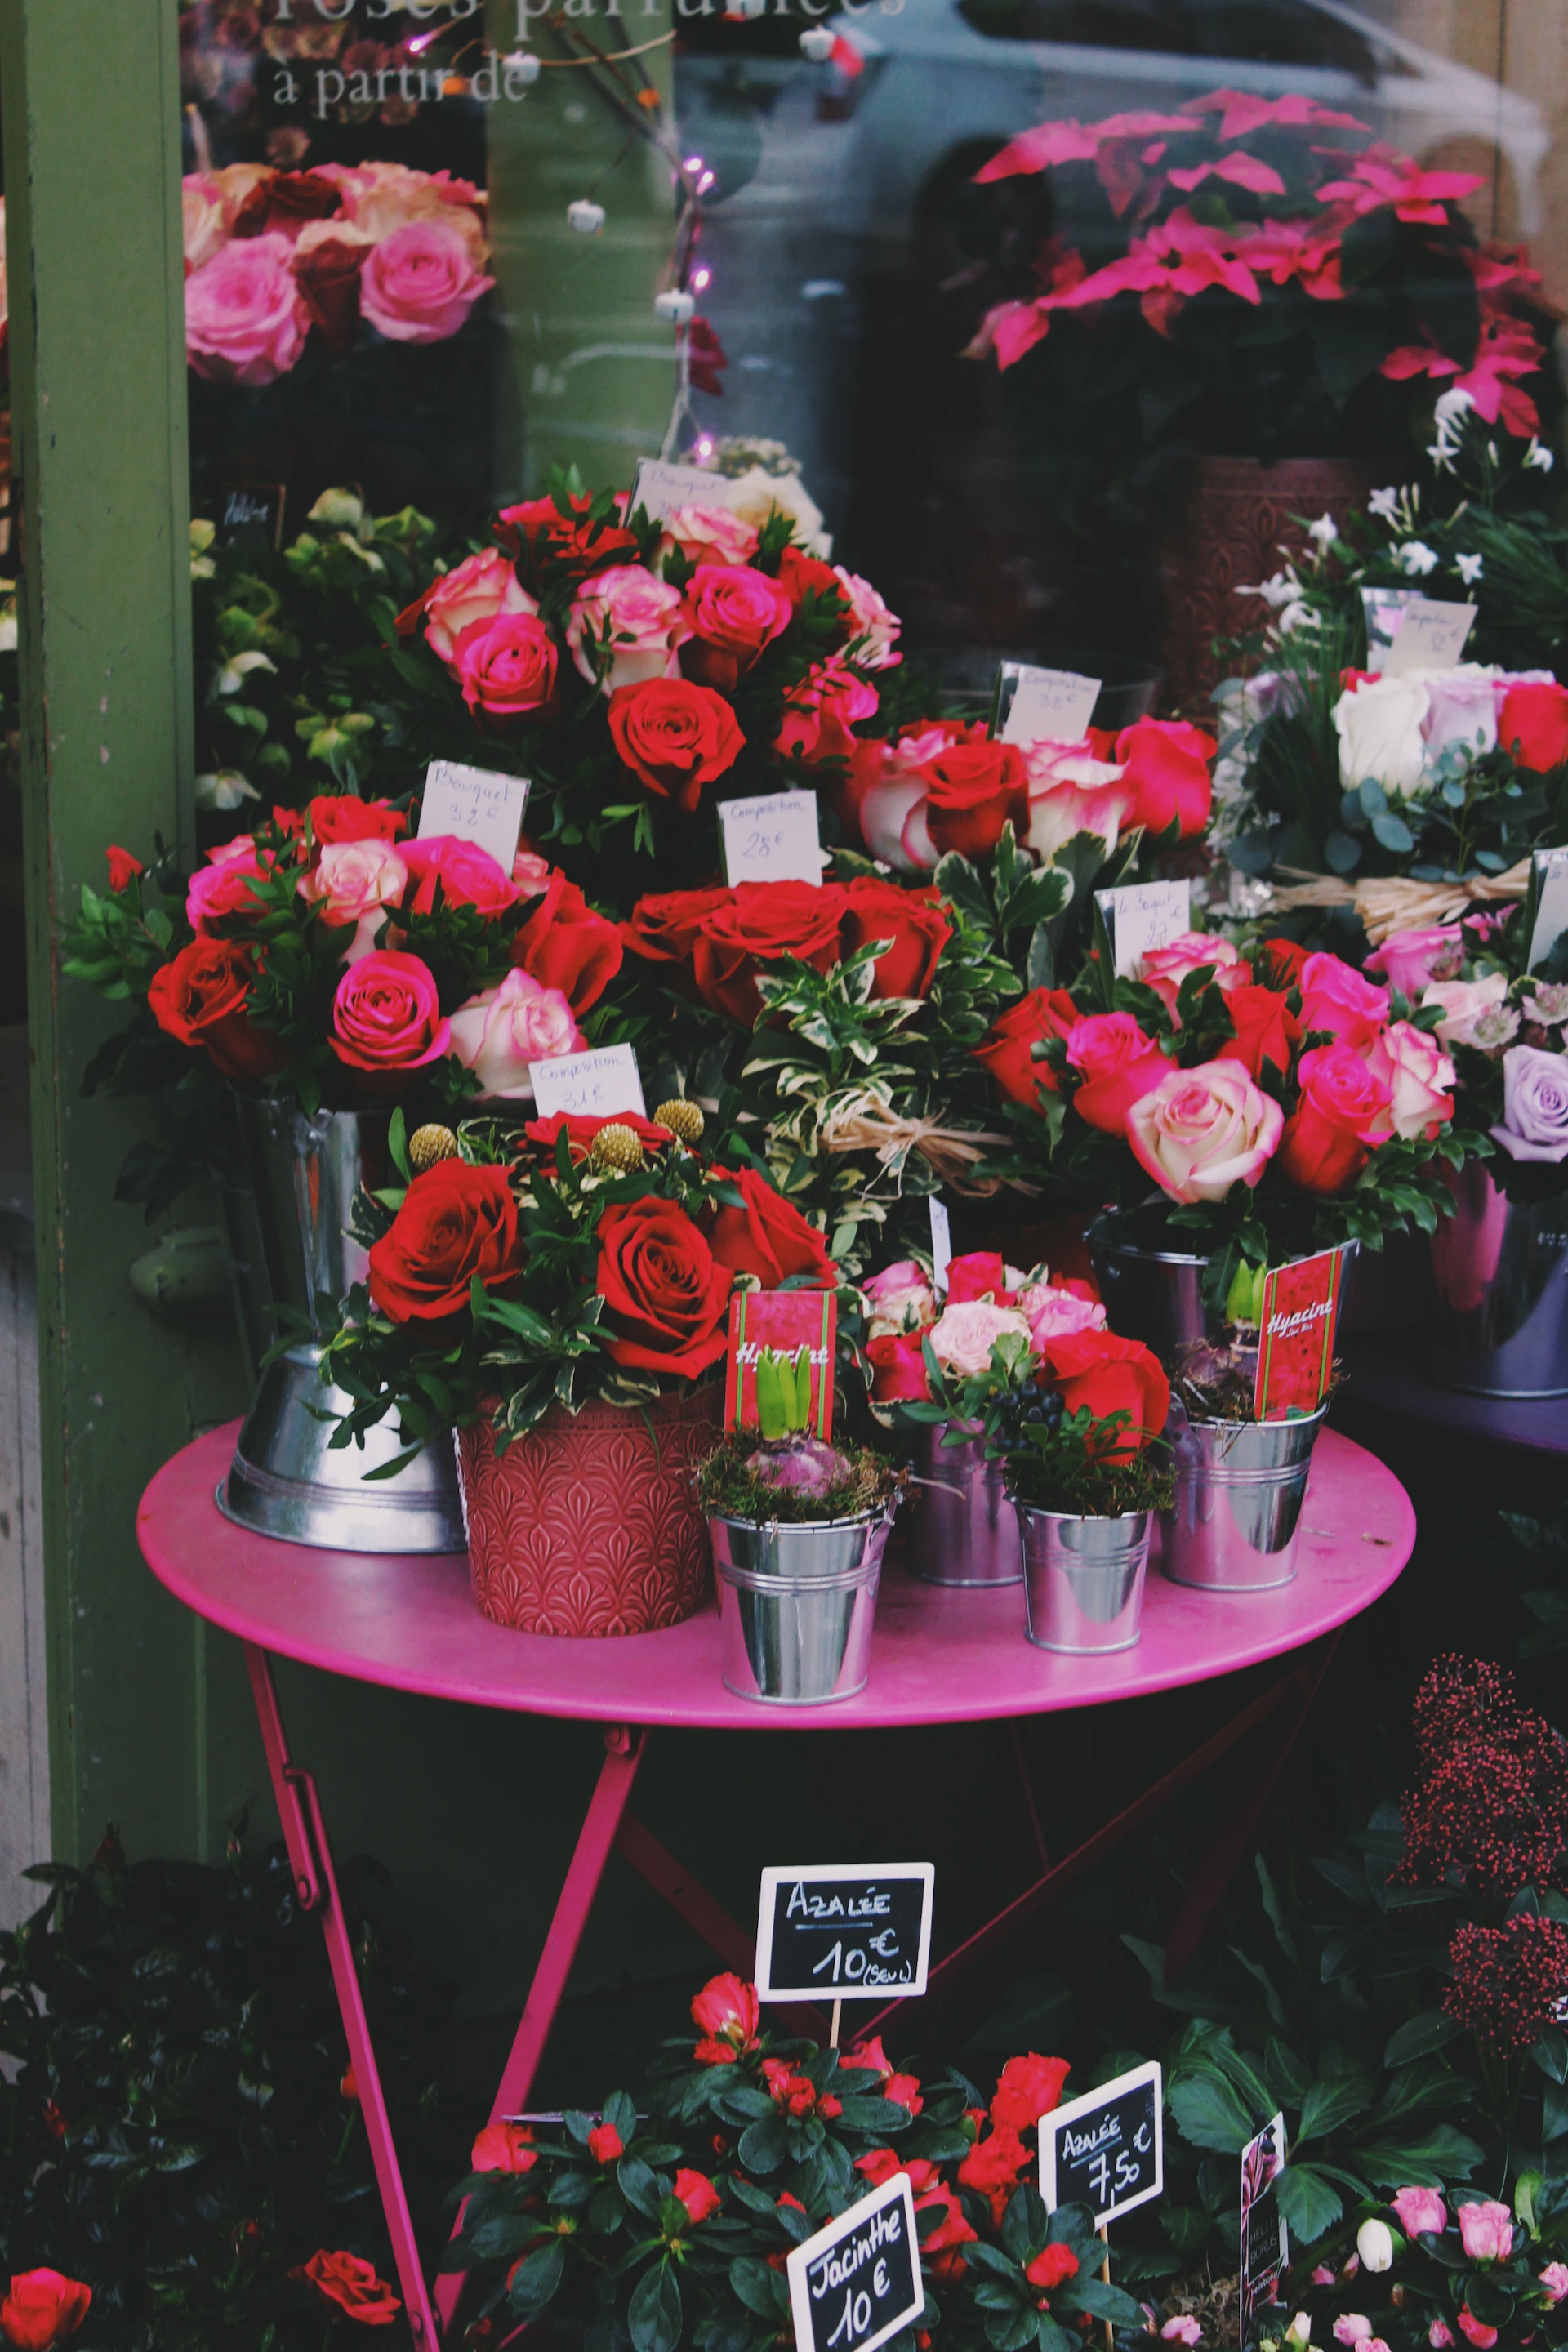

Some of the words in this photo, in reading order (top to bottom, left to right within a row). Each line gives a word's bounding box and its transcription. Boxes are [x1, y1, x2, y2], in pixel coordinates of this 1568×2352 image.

[313, 65, 453, 121] partir
[470, 49, 529, 104] de
[435, 768, 516, 805] Bouquet
[539, 1054, 625, 1081] Composition
[1267, 1295, 1334, 1339] Hyacint
[786, 1881, 892, 1918] AZALÉE
[1062, 2113, 1121, 2162] AZALÉE
[808, 2208, 902, 2300] Jacinthe
